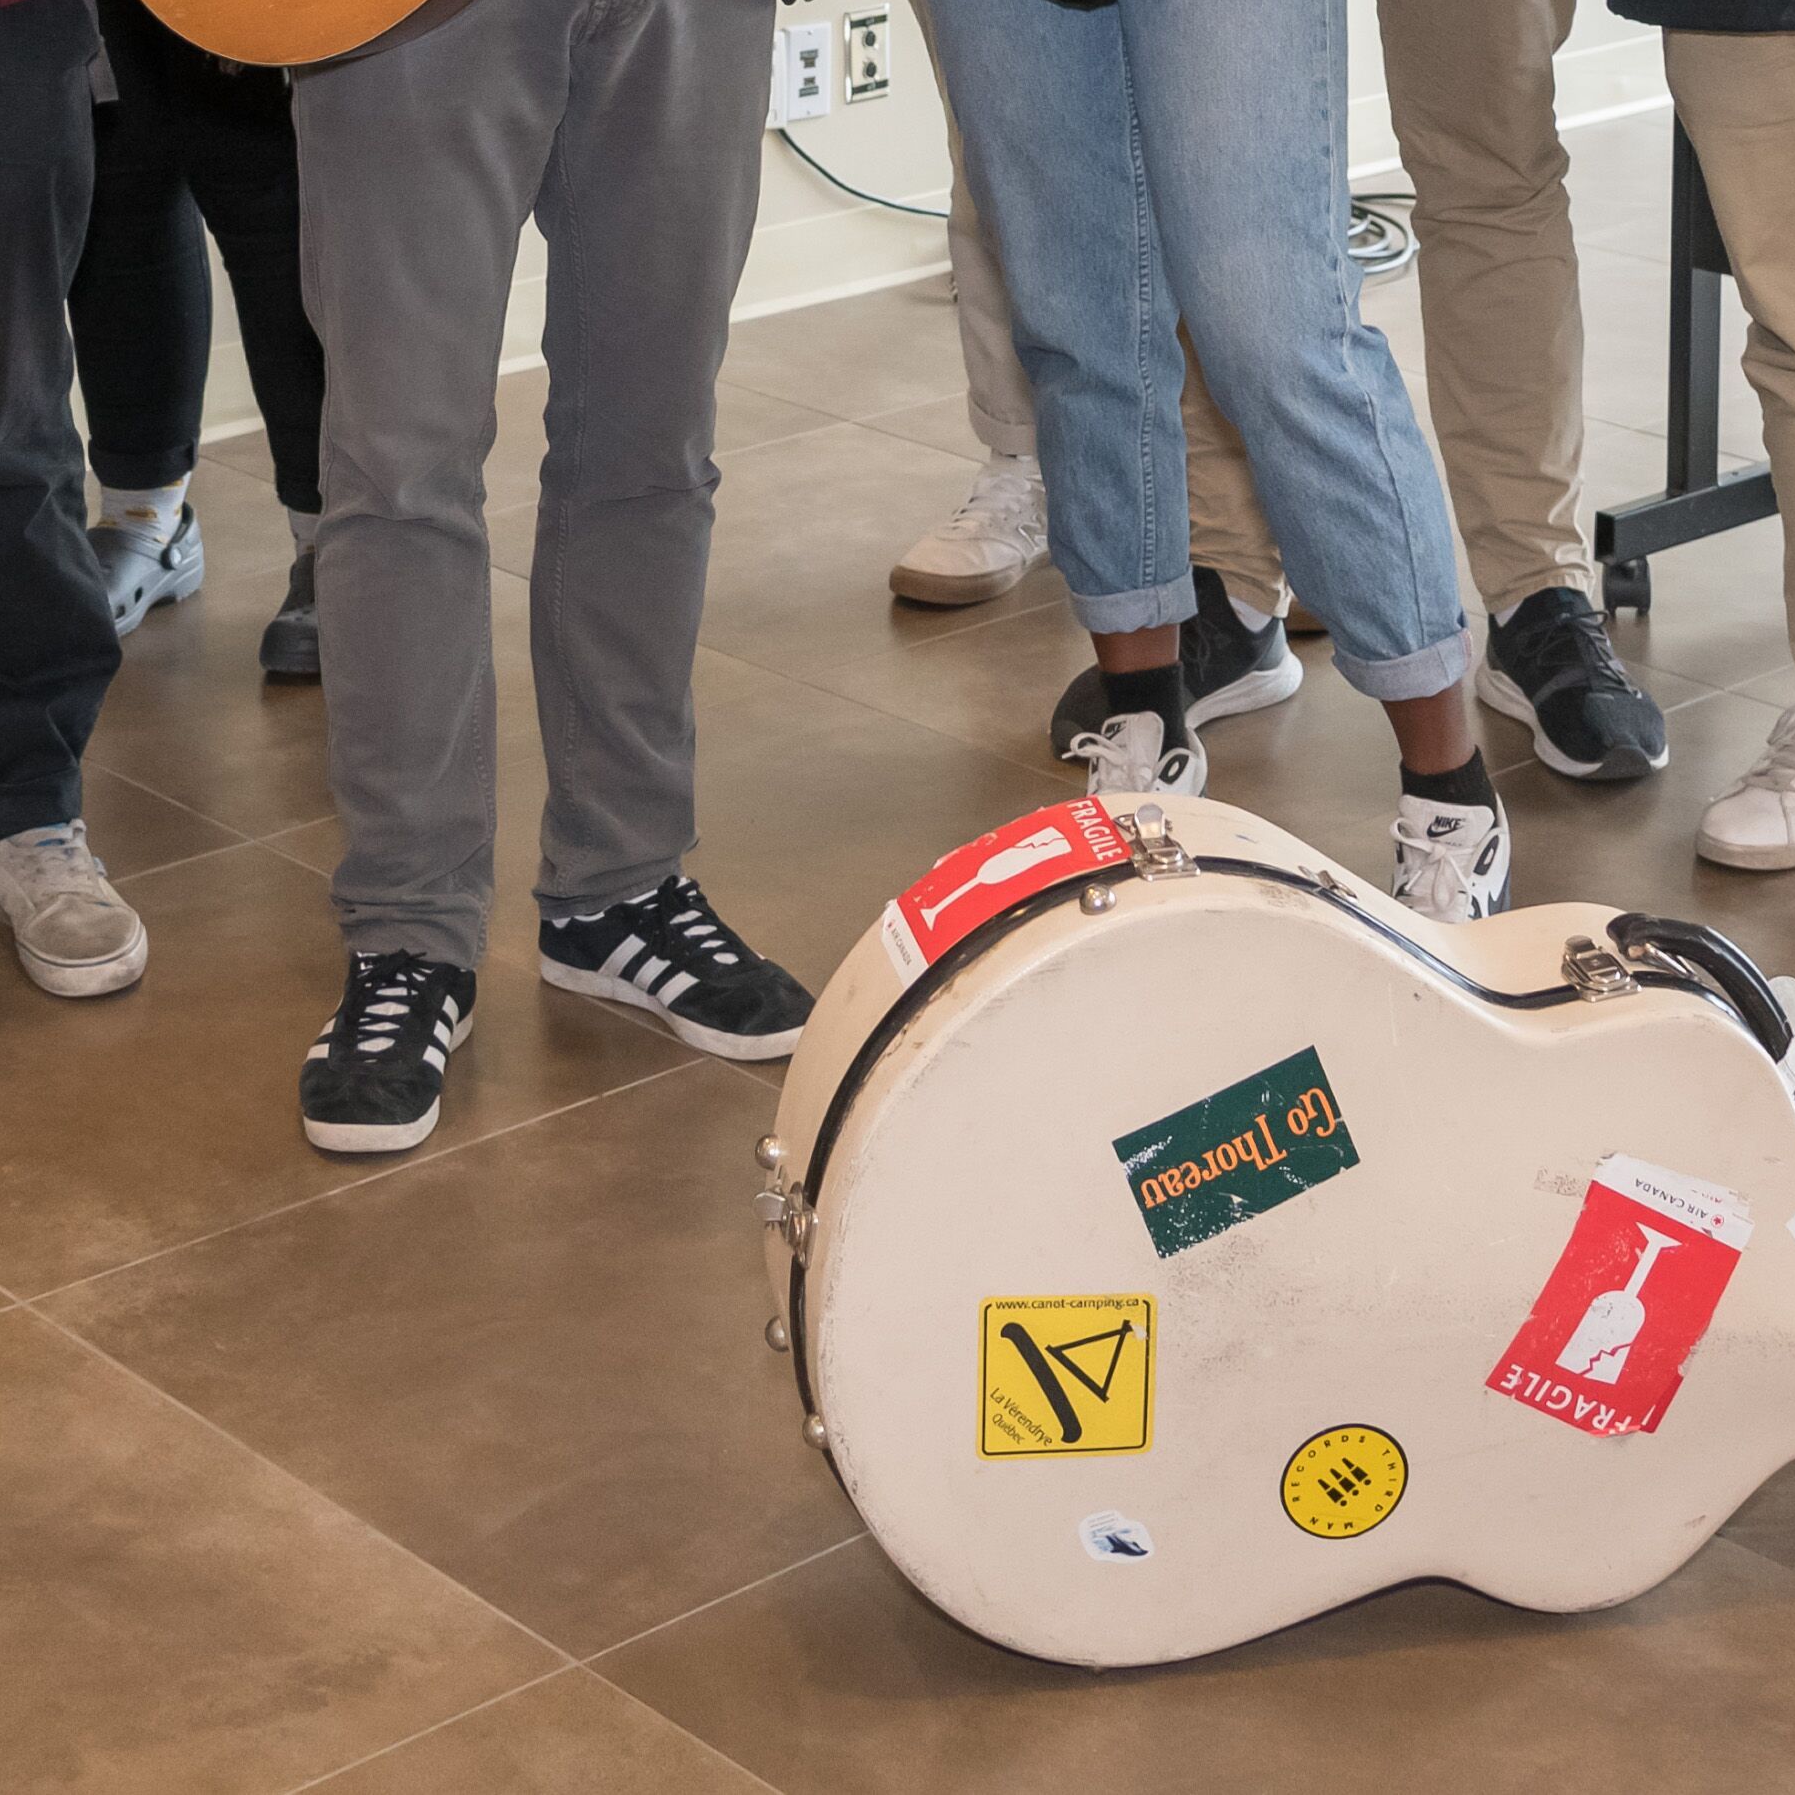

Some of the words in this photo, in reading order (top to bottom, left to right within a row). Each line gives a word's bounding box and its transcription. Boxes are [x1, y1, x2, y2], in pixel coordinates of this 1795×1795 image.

[1066, 798, 1124, 862] FRAGILE
[1432, 815, 1462, 830] NIKE
[1287, 1087, 1338, 1138] Go
[1140, 1114, 1288, 1209] Thoreau
[1634, 1177, 1687, 1209] CANADA
[1688, 1203, 1709, 1220] AIR
[995, 1298, 1140, 1311] www.canot-camping.ca
[989, 1387, 1005, 1404] La
[1003, 1397, 1053, 1447] Vérendrye
[1500, 1362, 1656, 1435] FRAGILE
[991, 1412, 1026, 1445] Québec
[1291, 1435, 1366, 1503] RECORDS
[1374, 1448, 1397, 1512] THIRD
[1310, 1516, 1354, 1530] MAN
